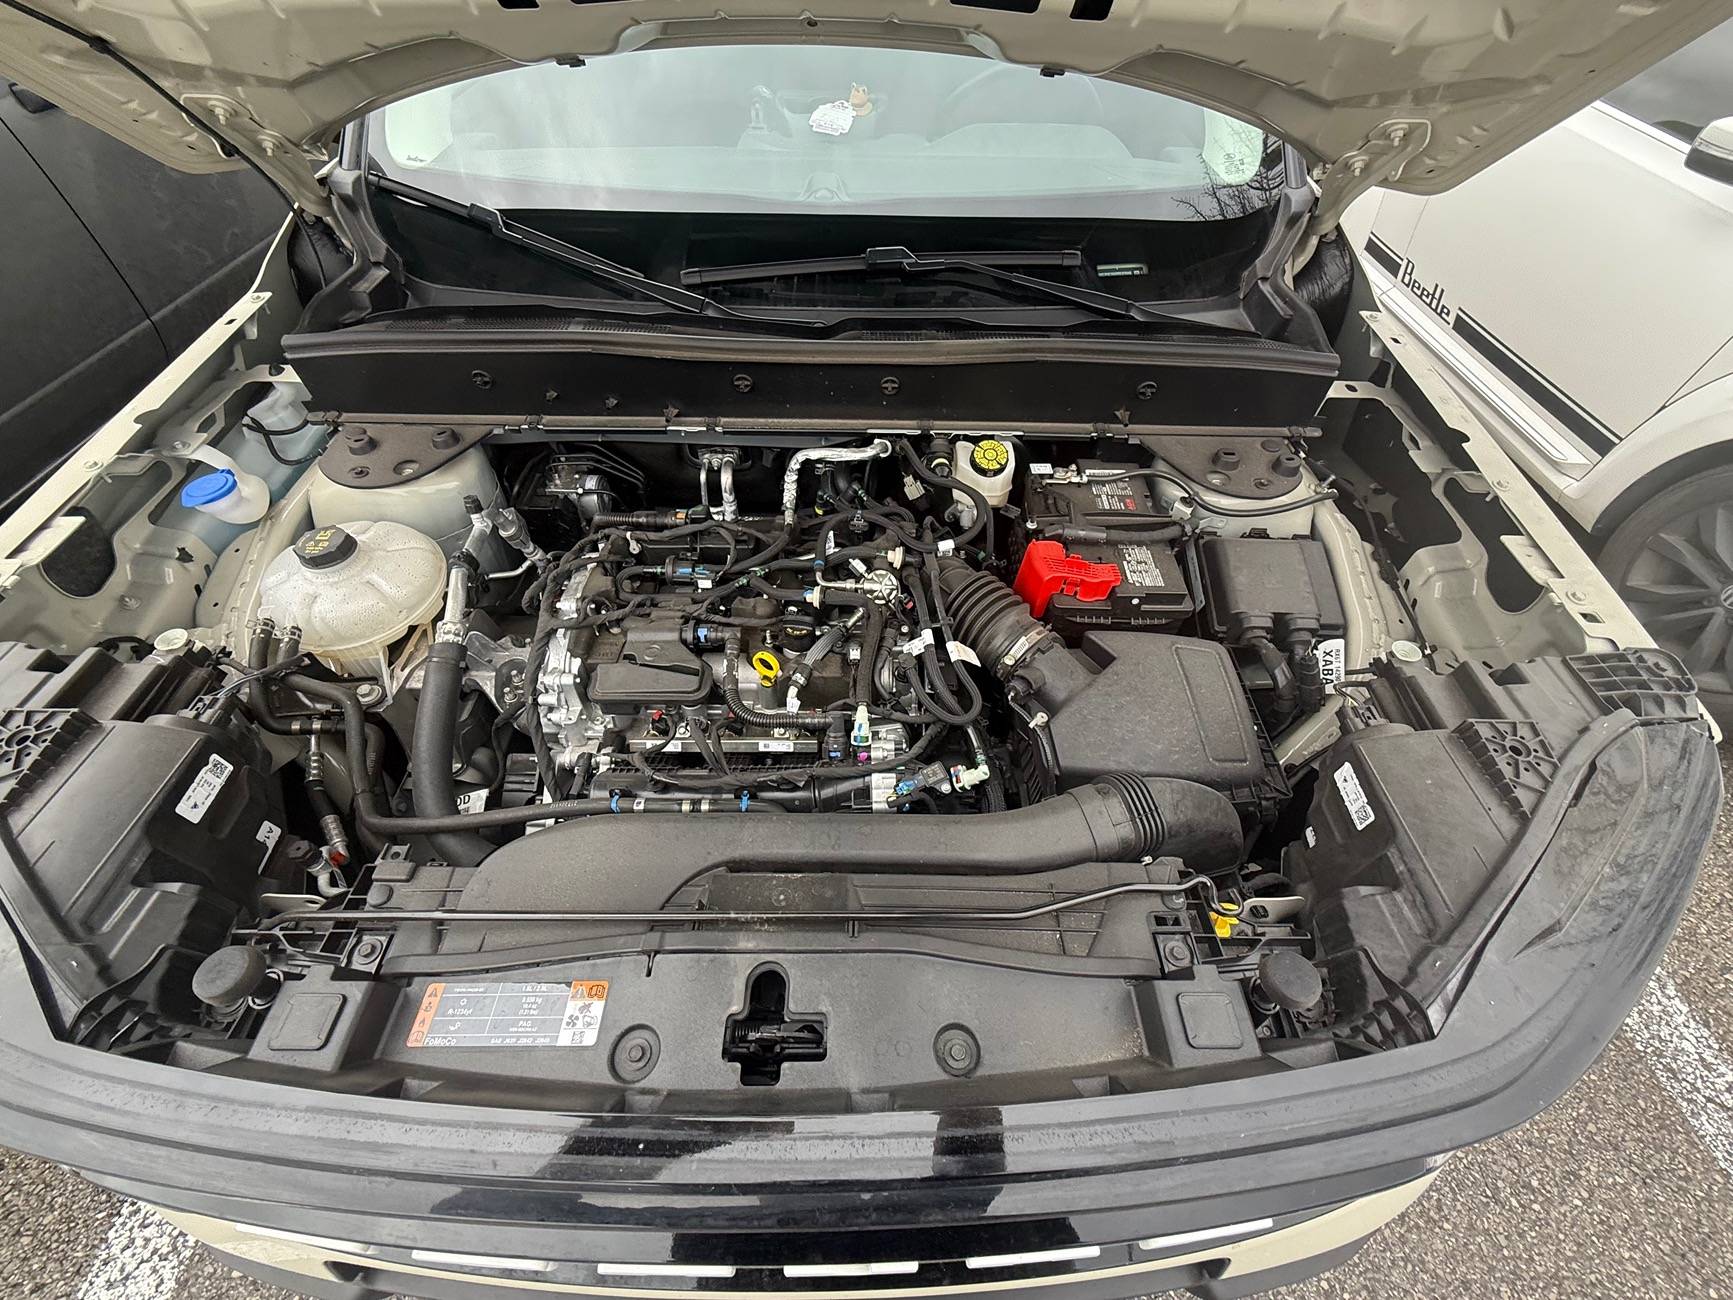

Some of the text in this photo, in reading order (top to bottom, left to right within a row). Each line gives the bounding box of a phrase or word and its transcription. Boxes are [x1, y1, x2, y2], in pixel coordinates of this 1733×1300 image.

[1401, 257, 1451, 325] Beetle
[1321, 650, 1335, 685] XABA
[424, 1037, 457, 1046] FoMoCo
